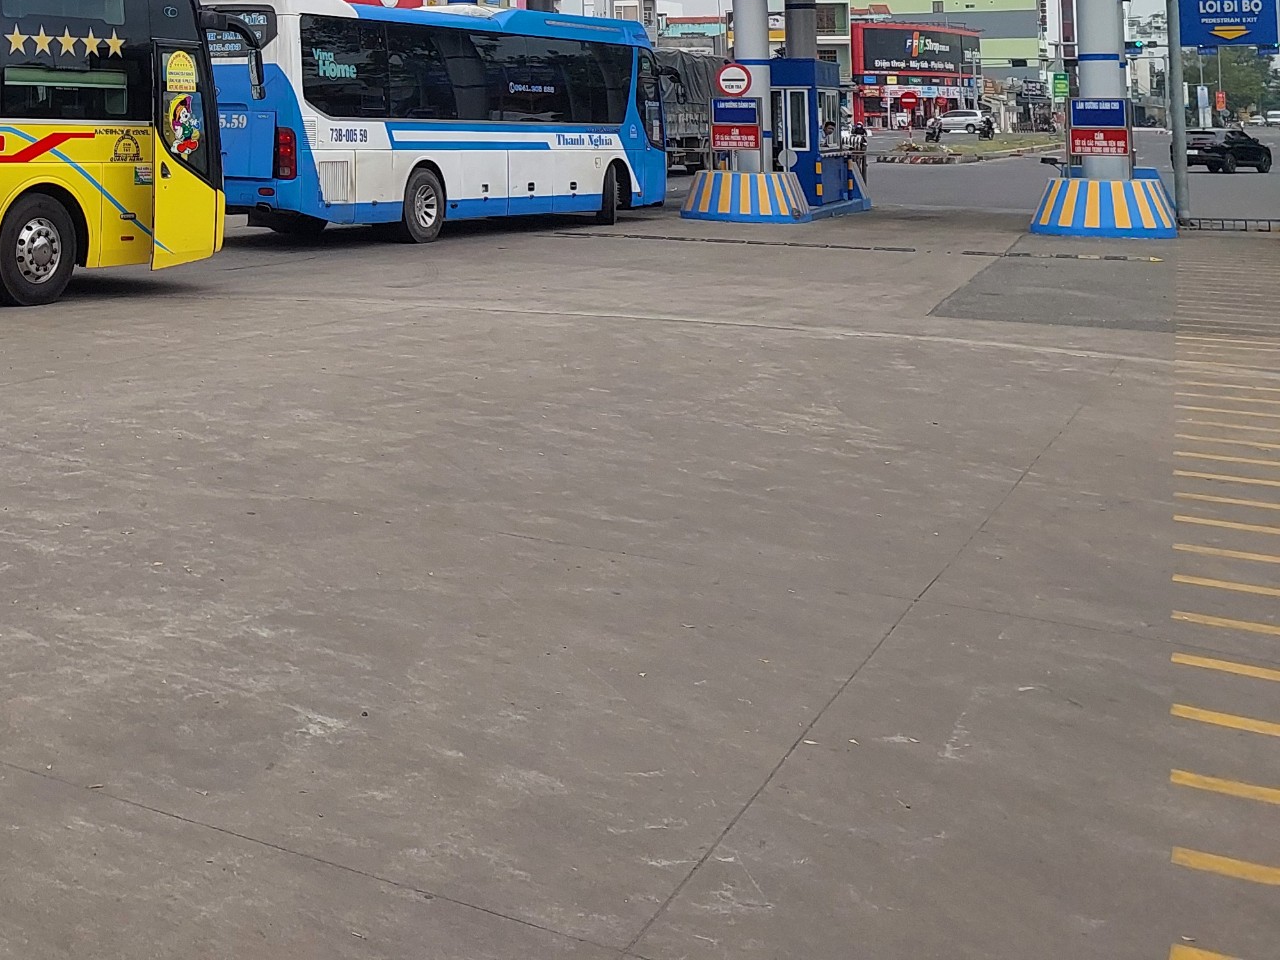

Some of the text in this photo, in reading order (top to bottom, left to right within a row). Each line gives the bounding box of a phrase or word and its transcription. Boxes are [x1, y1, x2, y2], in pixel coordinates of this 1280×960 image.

[1223, 0, 1238, 13] ĐI
[312, 48, 334, 62] Vina
[318, 60, 357, 81] Home
[329, 128, 358, 143] 73B-005
[556, 134, 585, 146] Thanh
